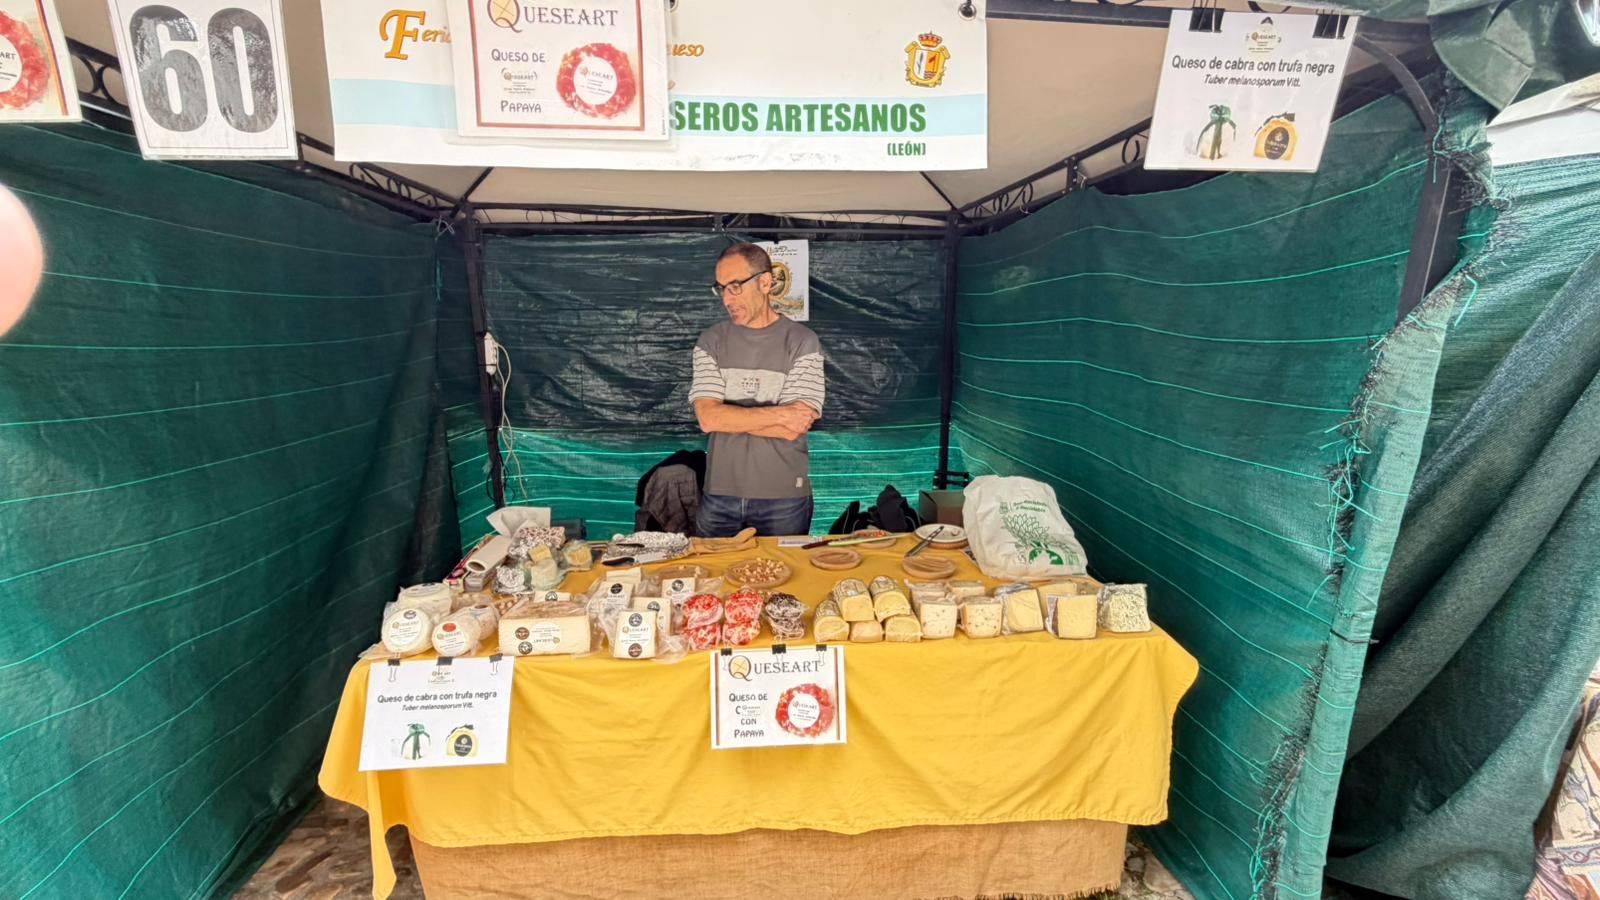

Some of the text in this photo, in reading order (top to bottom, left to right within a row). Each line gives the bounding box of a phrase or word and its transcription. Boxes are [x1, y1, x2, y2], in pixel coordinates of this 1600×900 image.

[487, 0, 618, 33] QUESEART
[491, 48, 546, 62] QUESO DE
[129, 4, 279, 133] 60
[1172, 55, 1335, 76] Queso de cabra con trufa negra
[1204, 74, 1227, 84] Tuber
[1228, 75, 1285, 88] melanosporum
[500, 100, 541, 113] PAPAYA
[766, 103, 926, 132] ARTESANOS
[887, 141, 926, 156] (LEÓN)
[728, 655, 820, 682] QUESEART
[377, 694, 402, 704] Queso
[404, 694, 414, 702] de
[415, 692, 437, 701] cabra
[455, 691, 473, 699] trufa
[475, 691, 497, 701] negra
[729, 692, 768, 702] QUESO DE
[734, 729, 764, 738] PAPAYA
